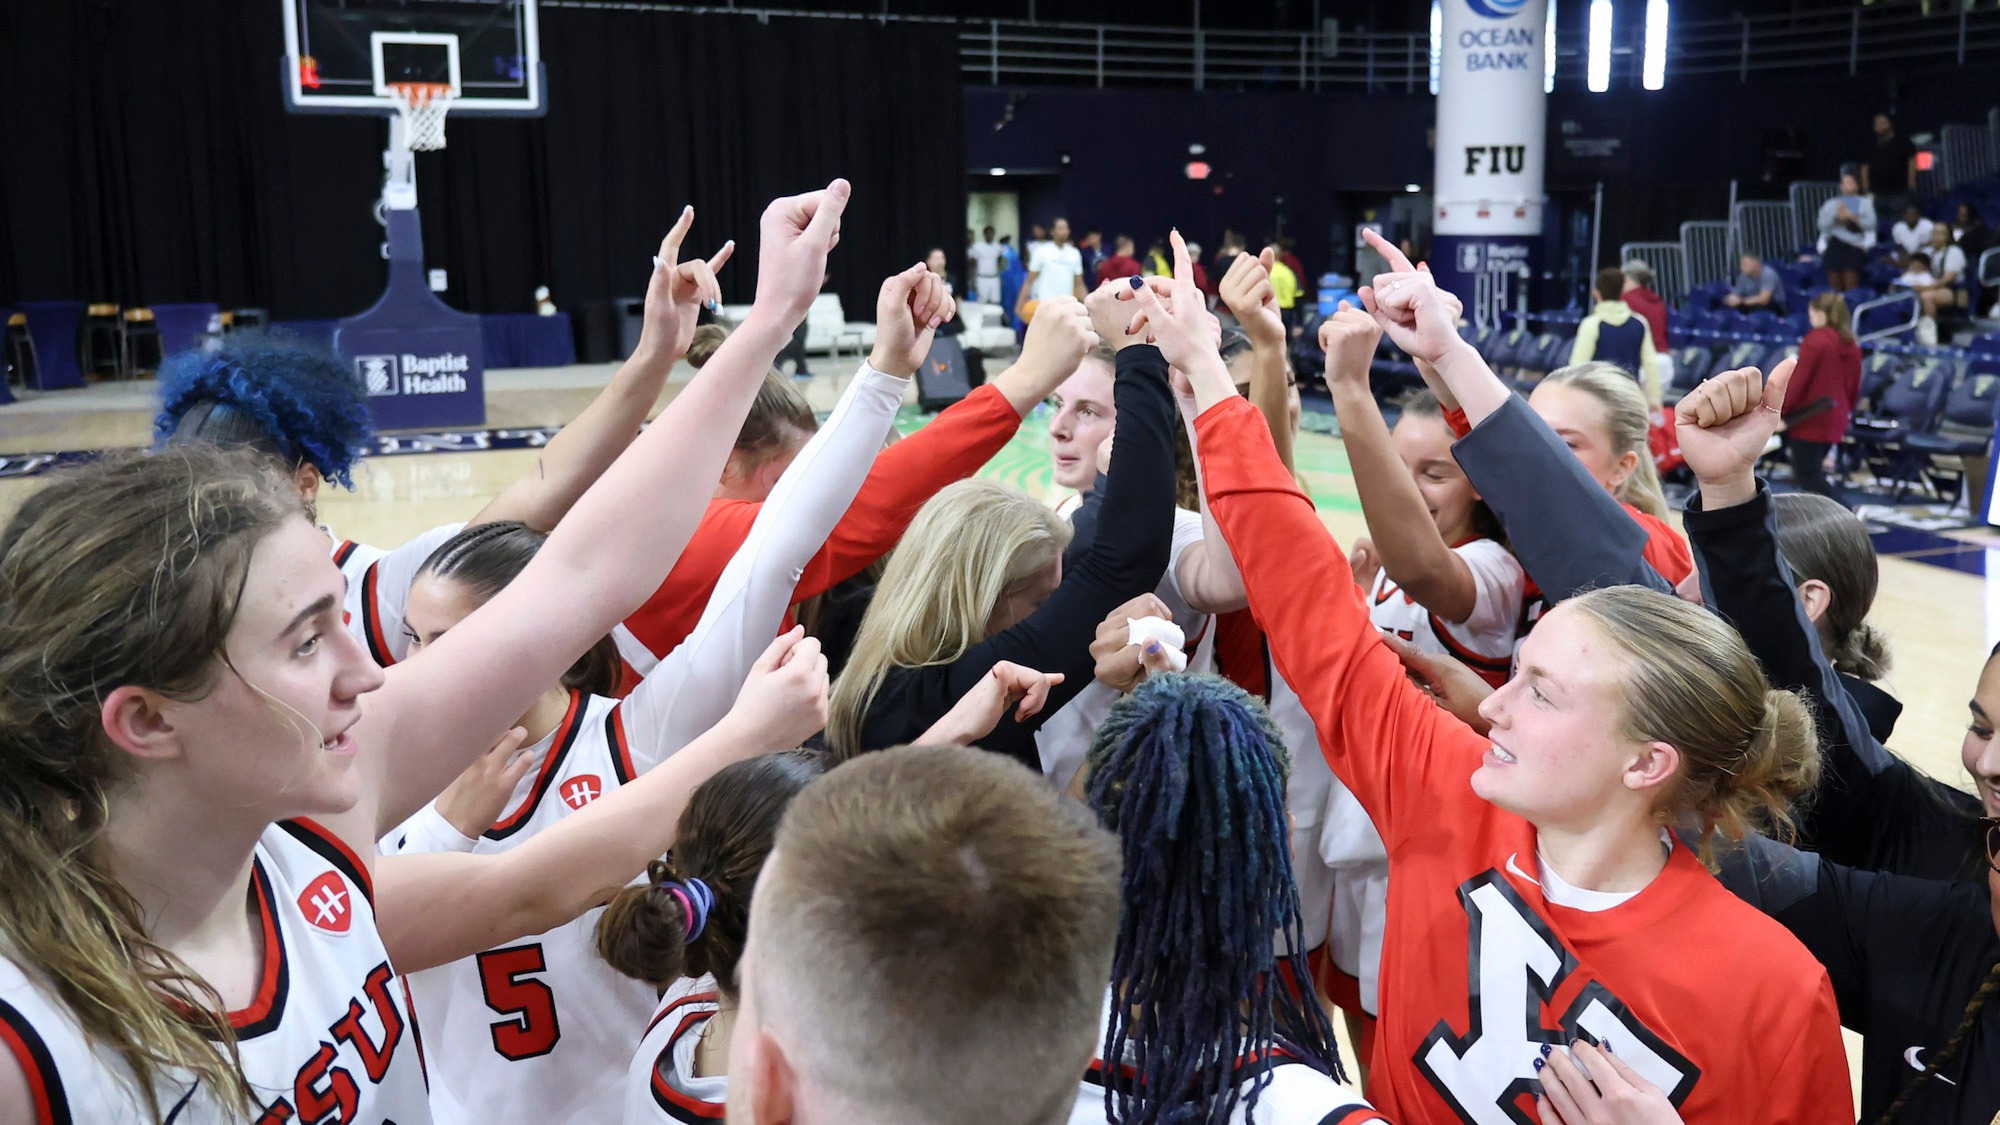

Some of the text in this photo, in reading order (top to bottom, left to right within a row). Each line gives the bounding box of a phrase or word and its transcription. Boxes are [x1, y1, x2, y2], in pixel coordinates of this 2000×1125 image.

[1459, 28, 1534, 48] OCEAN
[1466, 52, 1528, 71] BANK
[1465, 146, 1525, 174] FIU
[401, 352, 469, 377] Baptist
[402, 373, 467, 394] Health
[475, 942, 561, 1062] 5
